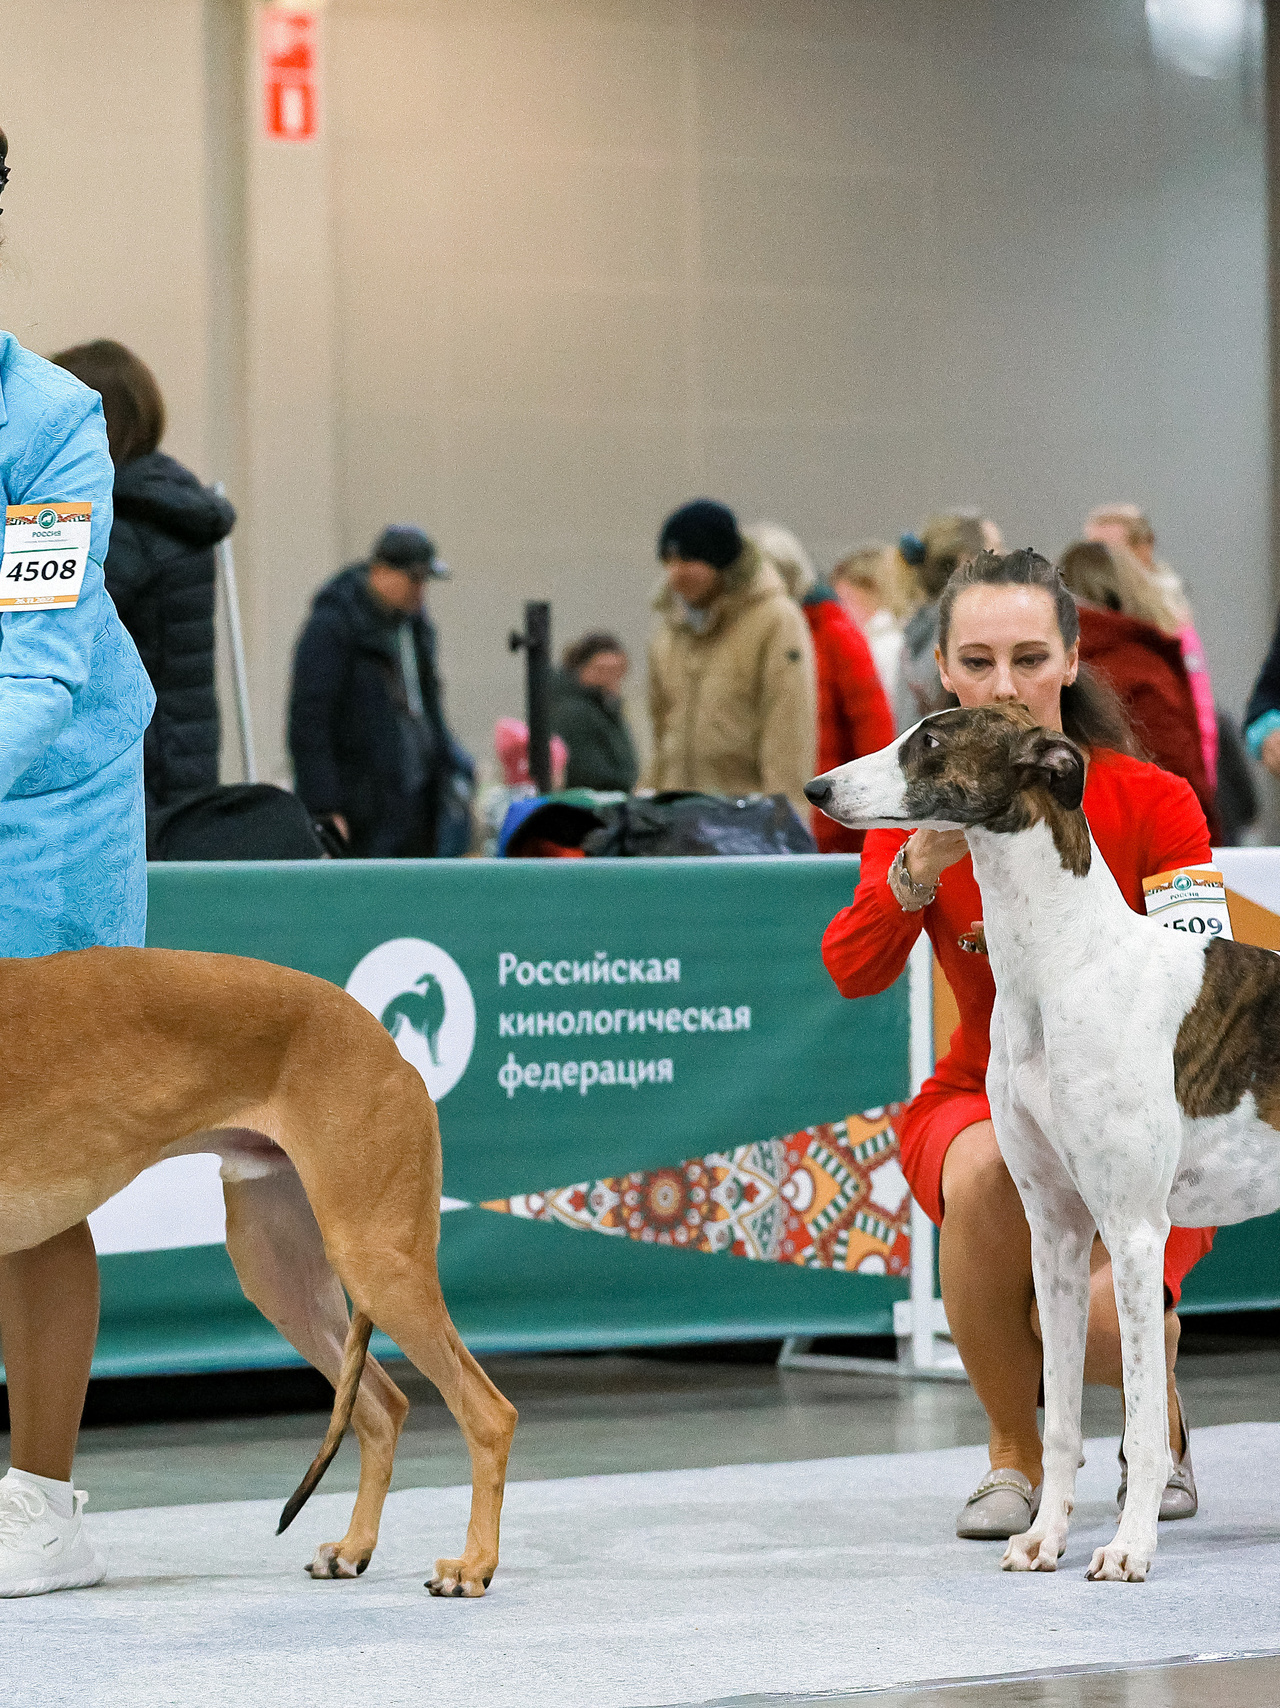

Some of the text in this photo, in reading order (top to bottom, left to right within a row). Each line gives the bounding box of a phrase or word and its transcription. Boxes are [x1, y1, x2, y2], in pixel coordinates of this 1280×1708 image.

[6, 559, 77, 582] 4508
[1163, 916, 1223, 935] 509
[498, 952, 681, 987] Российская
[498, 1004, 752, 1038] кинологическая
[497, 1055, 674, 1098] федерация
